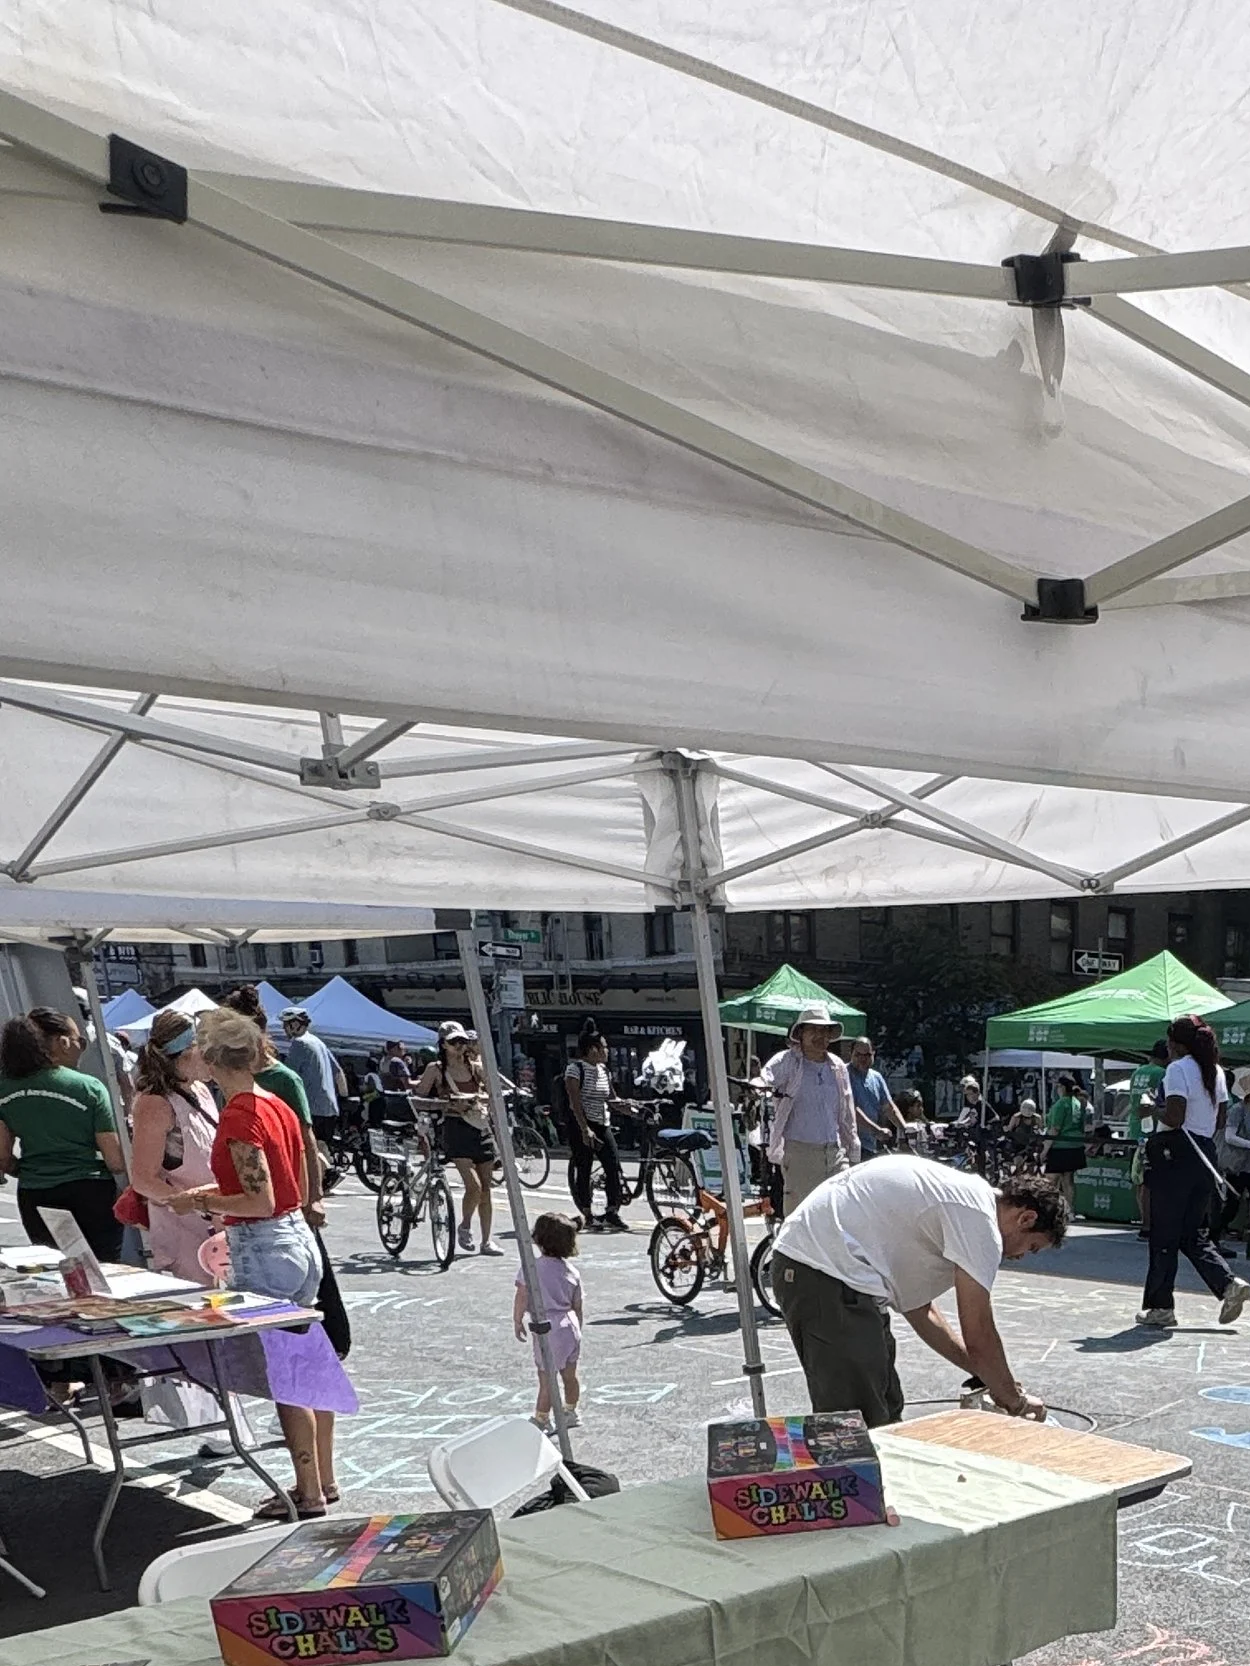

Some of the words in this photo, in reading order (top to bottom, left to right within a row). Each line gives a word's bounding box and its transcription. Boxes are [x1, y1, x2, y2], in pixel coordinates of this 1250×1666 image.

[1081, 957, 1096, 968] ONE
[735, 1475, 860, 1511] SIDEWALK
[750, 1499, 848, 1526] CHALKS
[249, 1598, 411, 1638] SIDEWALK
[269, 1628, 398, 1659] CHALKS
